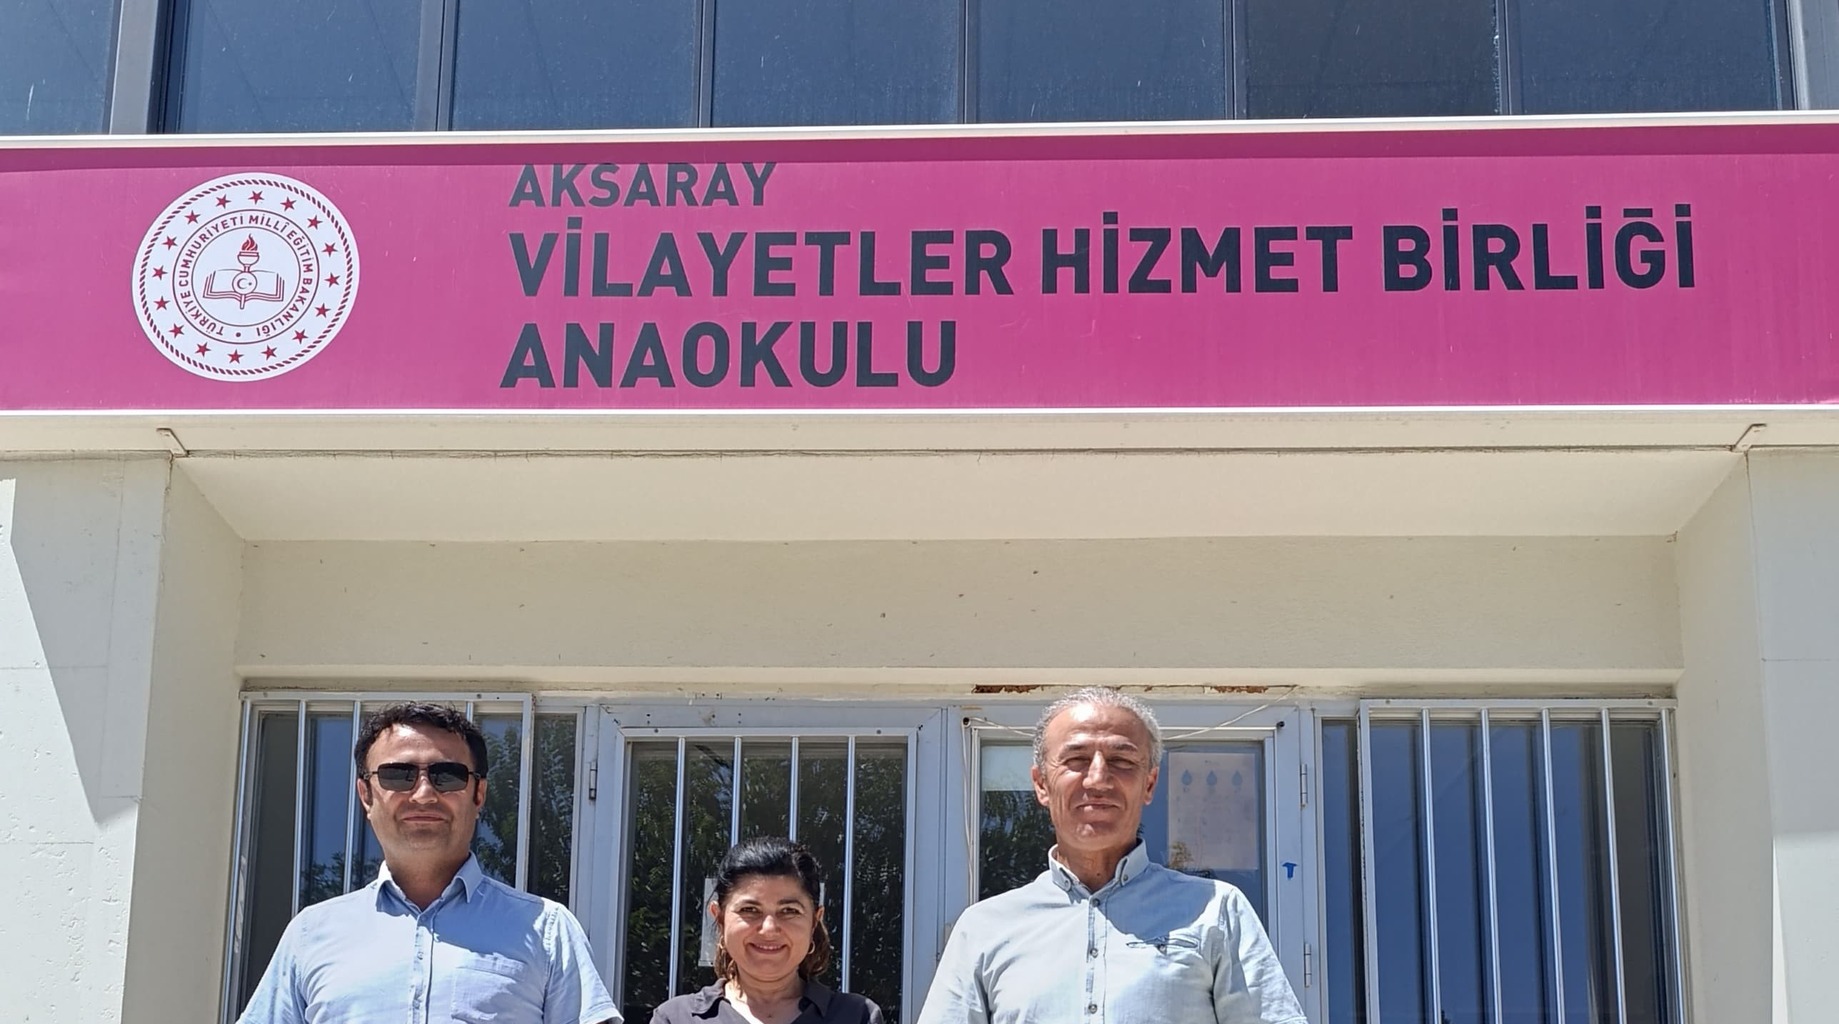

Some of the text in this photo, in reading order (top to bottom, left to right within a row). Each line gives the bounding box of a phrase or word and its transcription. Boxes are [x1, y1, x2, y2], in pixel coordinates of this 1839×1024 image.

[509, 162, 777, 207] AKSARAY
[178, 213, 244, 287] CUMHURİYETİ
[286, 229, 315, 273] EĞİTİM
[508, 203, 1695, 297] VİLAYETLER HİZMET BİRLİĞİ
[179, 290, 224, 336] TÜRKİYE
[255, 277, 313, 337] BAKANLIĞI
[499, 320, 957, 389] ANAOKULU
